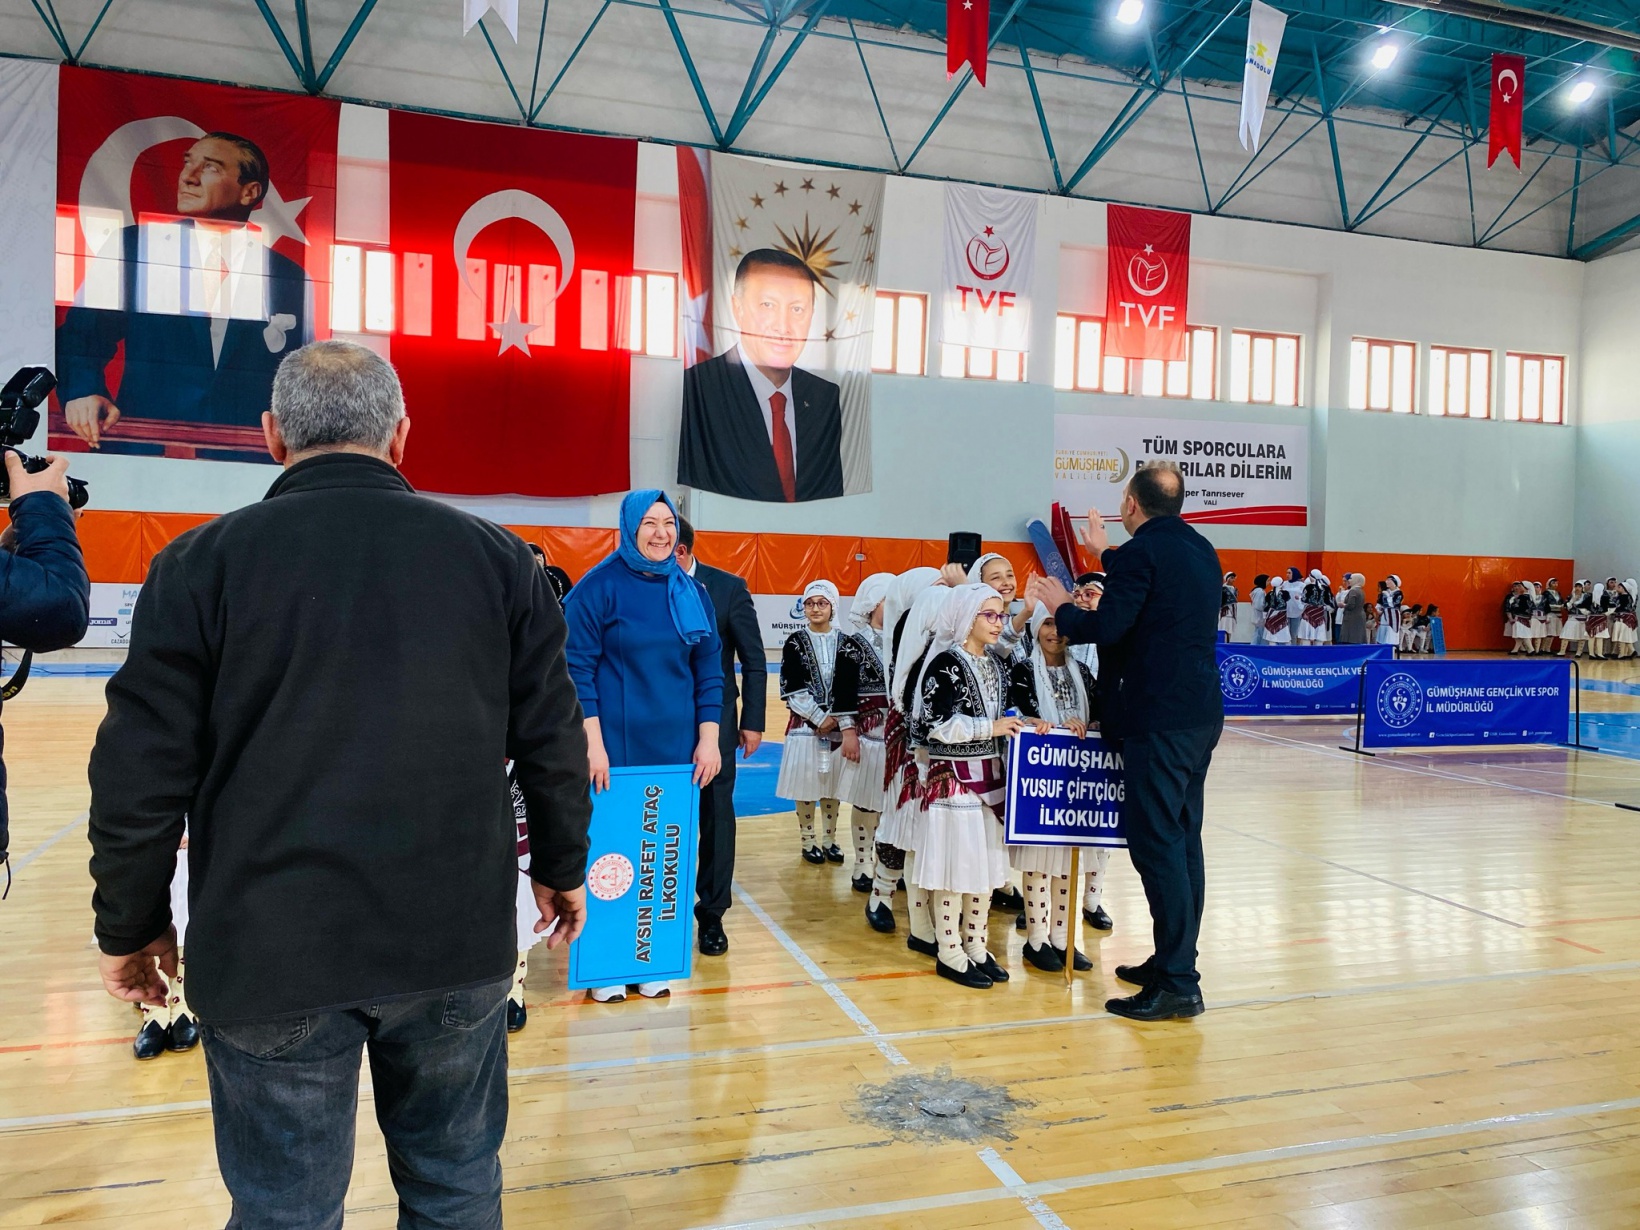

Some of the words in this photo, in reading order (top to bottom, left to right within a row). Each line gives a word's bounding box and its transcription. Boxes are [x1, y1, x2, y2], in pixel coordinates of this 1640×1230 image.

[956, 285, 1016, 317] TVF
[1119, 302, 1175, 330] TVF
[1143, 435, 1178, 455] TÜM
[1183, 440, 1286, 459] SPORCULARA
[1231, 460, 1292, 480] DİLERİM
[1185, 490, 1199, 498] per
[1201, 489, 1245, 499] Tanrısever
[122, 590, 138, 599] MA
[771, 622, 808, 631] MÜRŞİTH
[1261, 666, 1313, 678] GÜMÜŞHANE
[1315, 666, 1350, 678] GENÇLİK
[1262, 678, 1270, 688] İL
[1271, 678, 1324, 689] MÜDÜRLÜĞÜ
[1426, 685, 1485, 700] GÜMÜŞHANE
[1486, 685, 1523, 699] GENÇLİK
[1524, 687, 1536, 697] VE
[1537, 686, 1559, 697] SPOR
[1426, 701, 1434, 713] İL
[1435, 700, 1494, 713] MÜDÜRLÜĞÜ
[1027, 743, 1124, 773] GÜMÜŞHAN
[1020, 777, 1064, 799] YUSUF
[1066, 776, 1125, 806] ÇİFTÇİOĞ
[642, 784, 664, 834] ATAÇ
[1039, 803, 1119, 829] İLKOKULU
[638, 839, 657, 901] RAFET
[658, 823, 681, 921] İLKOKULU
[635, 906, 653, 963] AYSIN
